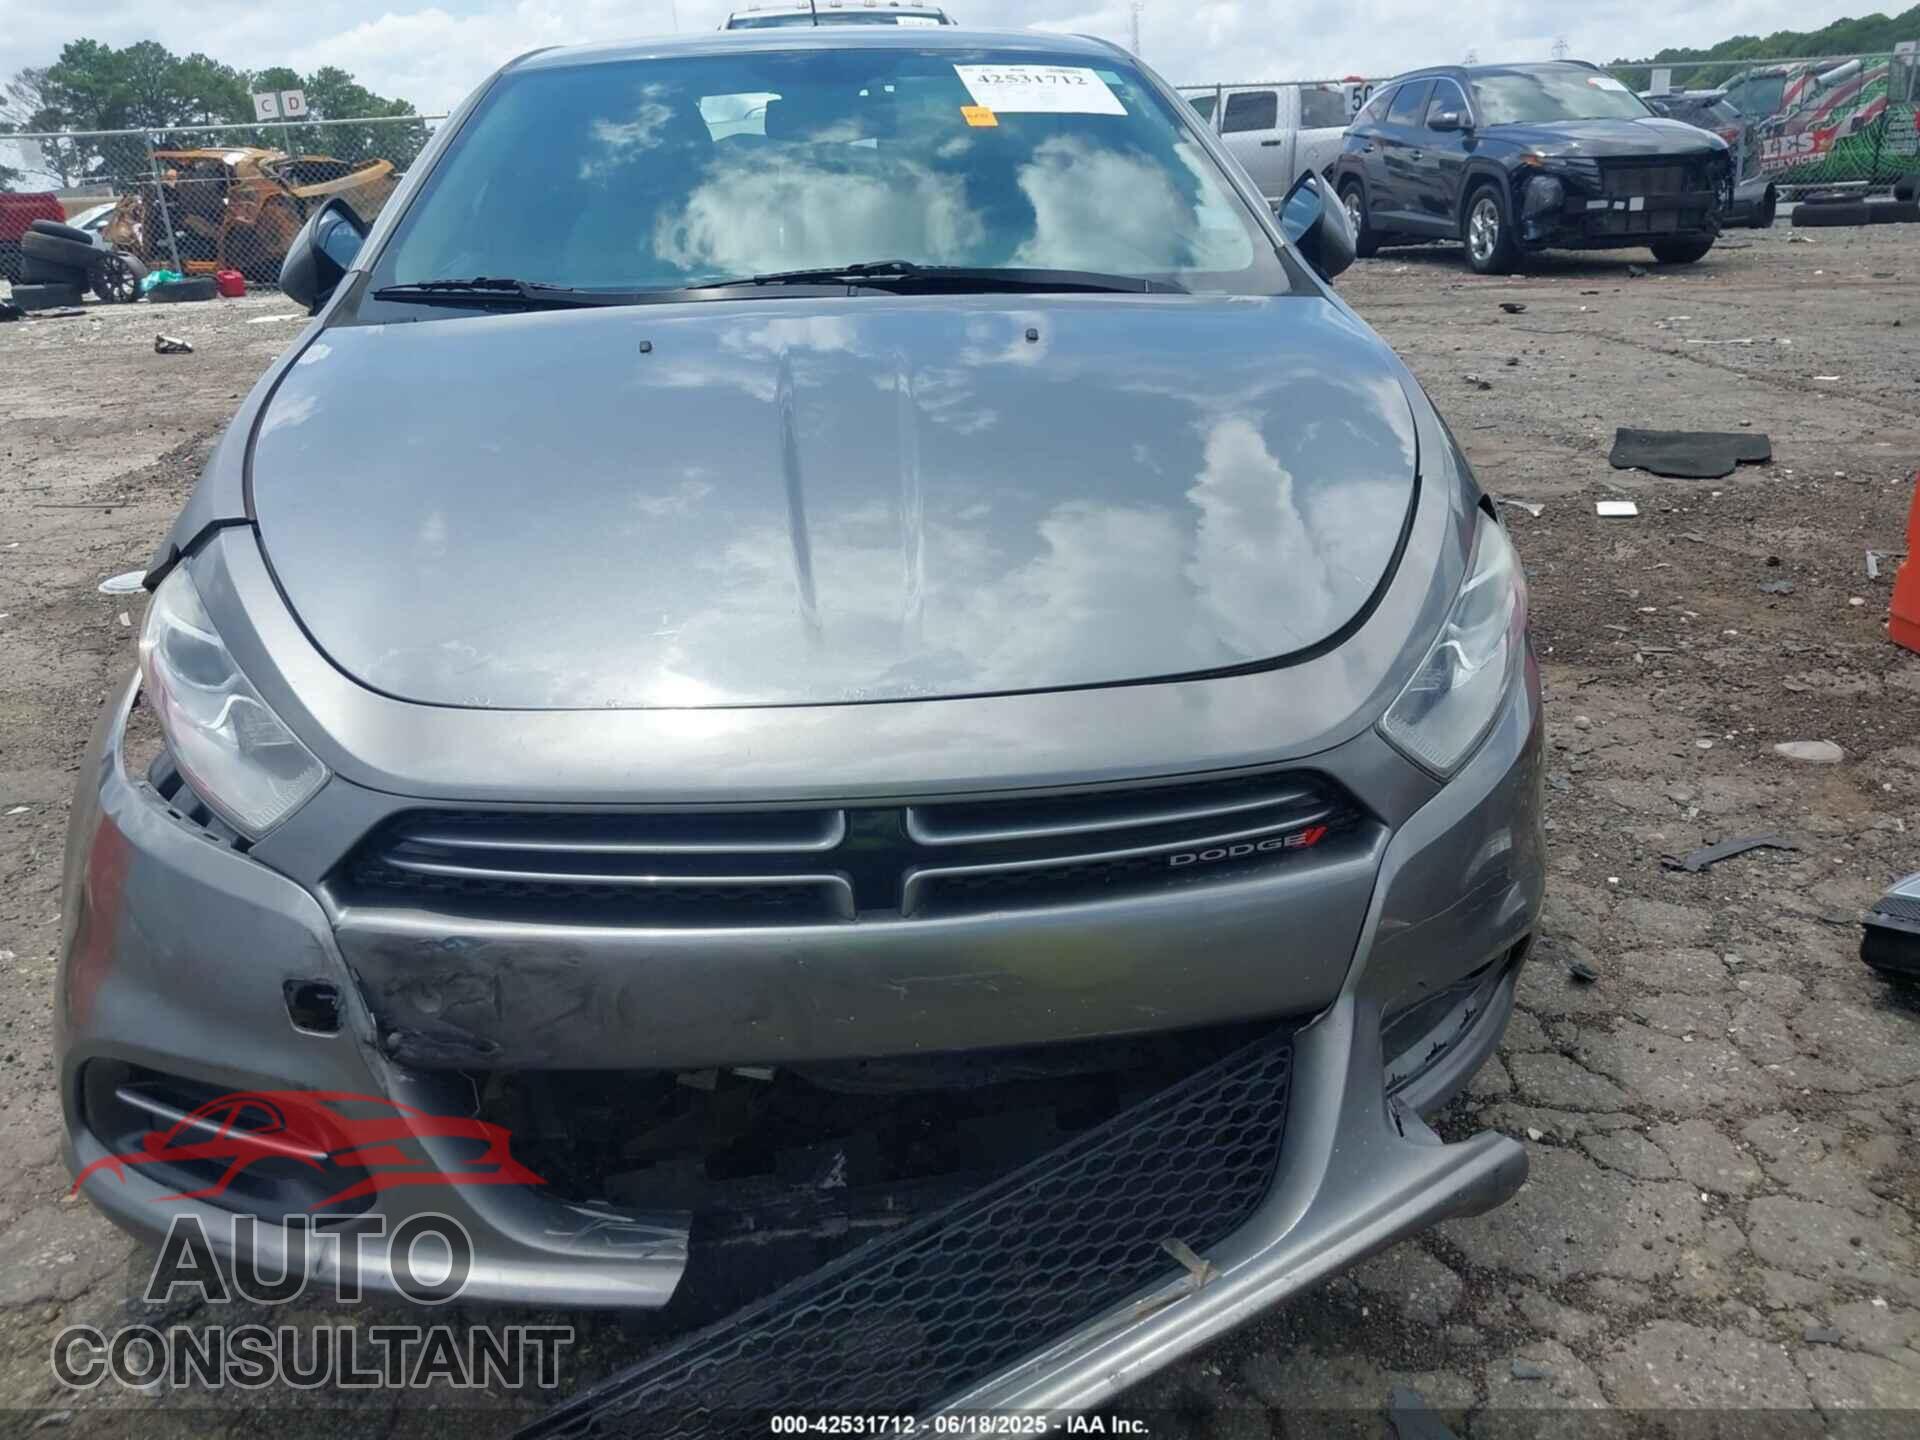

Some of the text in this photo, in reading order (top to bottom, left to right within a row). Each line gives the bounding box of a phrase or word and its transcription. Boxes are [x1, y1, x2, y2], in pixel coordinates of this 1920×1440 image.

[977, 74, 1088, 85] 42531712
[262, 99, 272, 112] C
[288, 97, 299, 110] D
[1760, 132, 1816, 159] LES
[1760, 152, 1826, 170] SERVICES
[1170, 832, 1307, 866] DODGE
